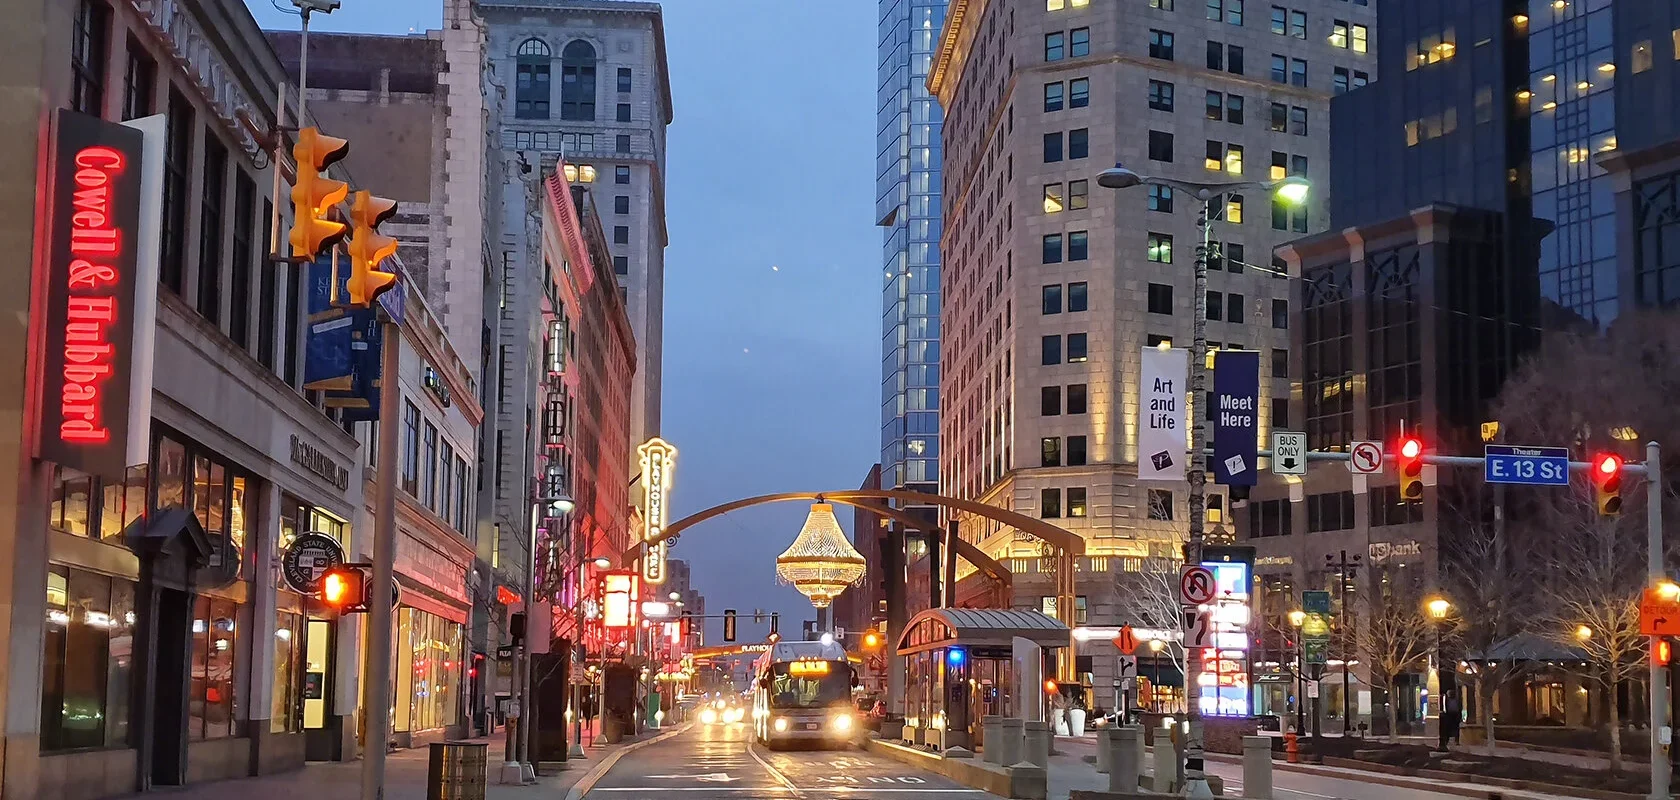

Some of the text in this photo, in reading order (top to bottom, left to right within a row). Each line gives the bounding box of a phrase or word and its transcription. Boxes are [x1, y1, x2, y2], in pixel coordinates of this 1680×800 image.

[318, 277, 347, 286] KET
[60, 147, 121, 439] Cowell & Hubbard
[317, 286, 347, 296] STTE
[1153, 377, 1173, 394] Art
[1150, 397, 1175, 412] and
[1220, 394, 1252, 410] Meet
[1150, 413, 1175, 429] Life
[1220, 412, 1251, 427] Here
[1280, 436, 1297, 445] BUS
[1278, 446, 1300, 456] ONLY
[1511, 447, 1541, 456] Theater
[1492, 459, 1563, 479] E. 13 St
[649, 452, 661, 578] PLAYHOUSE SUARE
[303, 540, 326, 549] STATE
[1643, 605, 1678, 614] DETOUR
